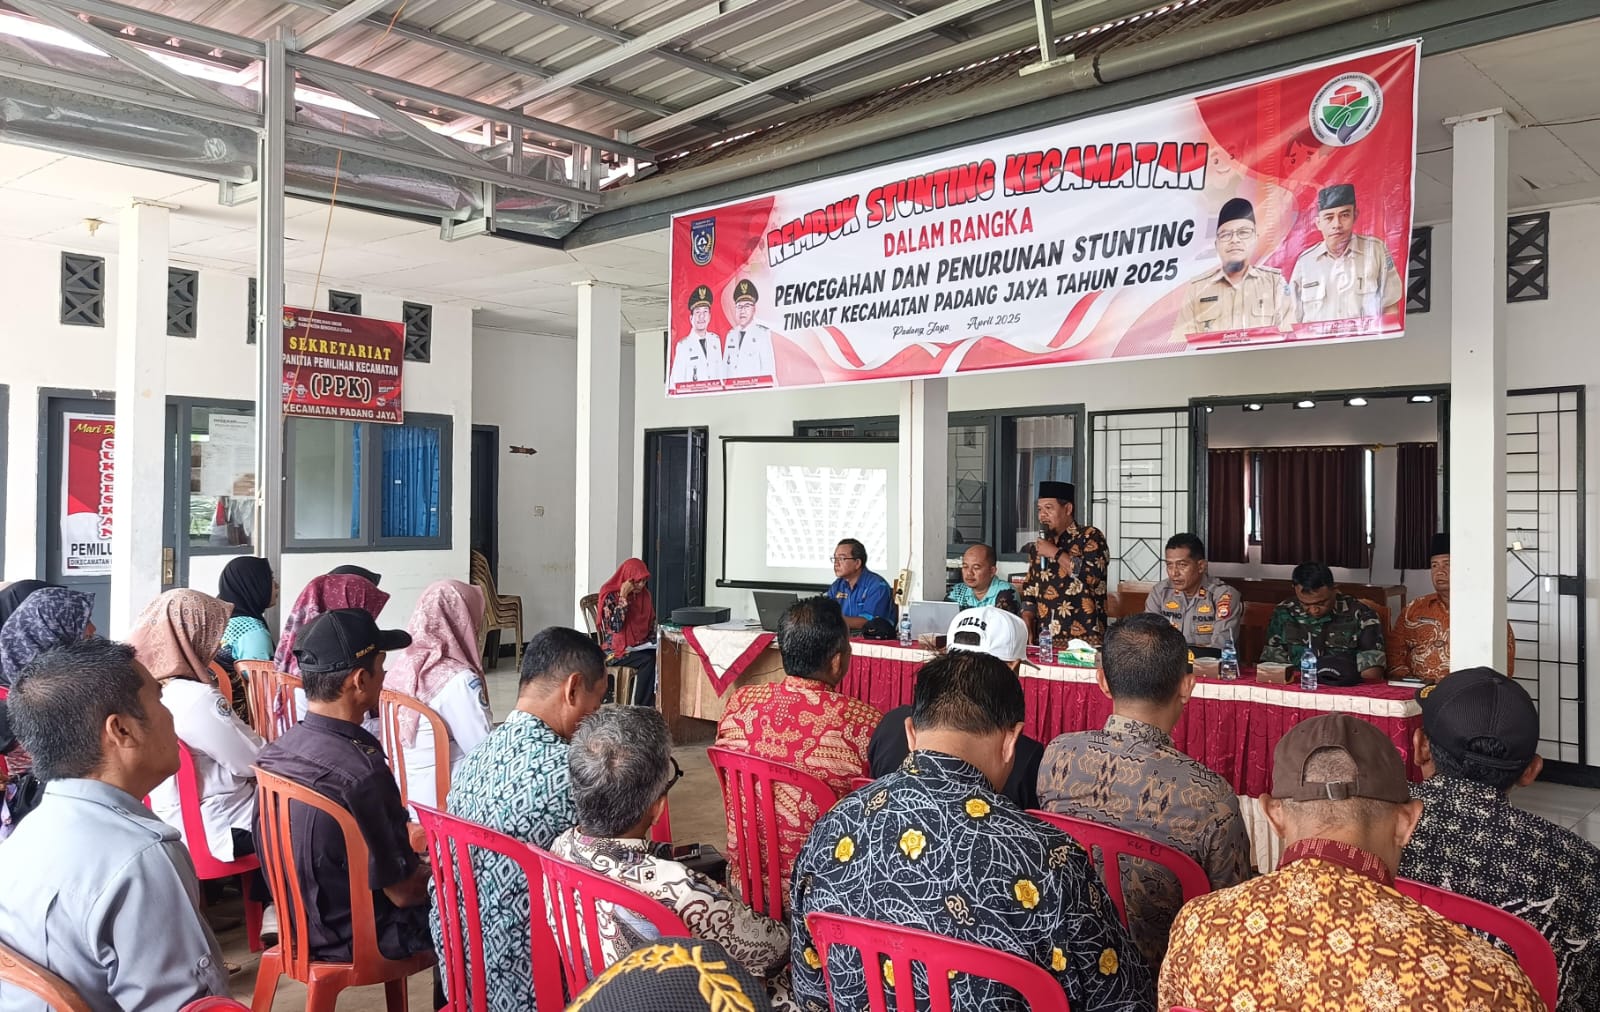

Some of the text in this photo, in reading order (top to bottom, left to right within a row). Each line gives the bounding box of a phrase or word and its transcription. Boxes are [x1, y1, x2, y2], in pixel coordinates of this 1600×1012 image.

[767, 142, 1208, 267] REMBUK STUNTING KECAMATAN
[884, 206, 1034, 258] DALAM RANGKA
[775, 219, 1196, 308] PENCEGAHAN DAN PENURUNAN STUNTING
[783, 257, 1179, 331] TINGKAT KECAMATAN PADANG JAYA TAHUN 2025
[893, 326, 924, 340] Padang
[968, 316, 993, 331] April
[995, 313, 1021, 326] 2025
[289, 336, 391, 361] SEKRETARIAT
[314, 357, 355, 371] PEMILIHAN
[356, 361, 398, 376] KECAMATAN
[310, 373, 372, 404] (PPK)
[283, 403, 396, 420] KECAMATAN PADANG JAYA
[73, 423, 102, 433] Mari
